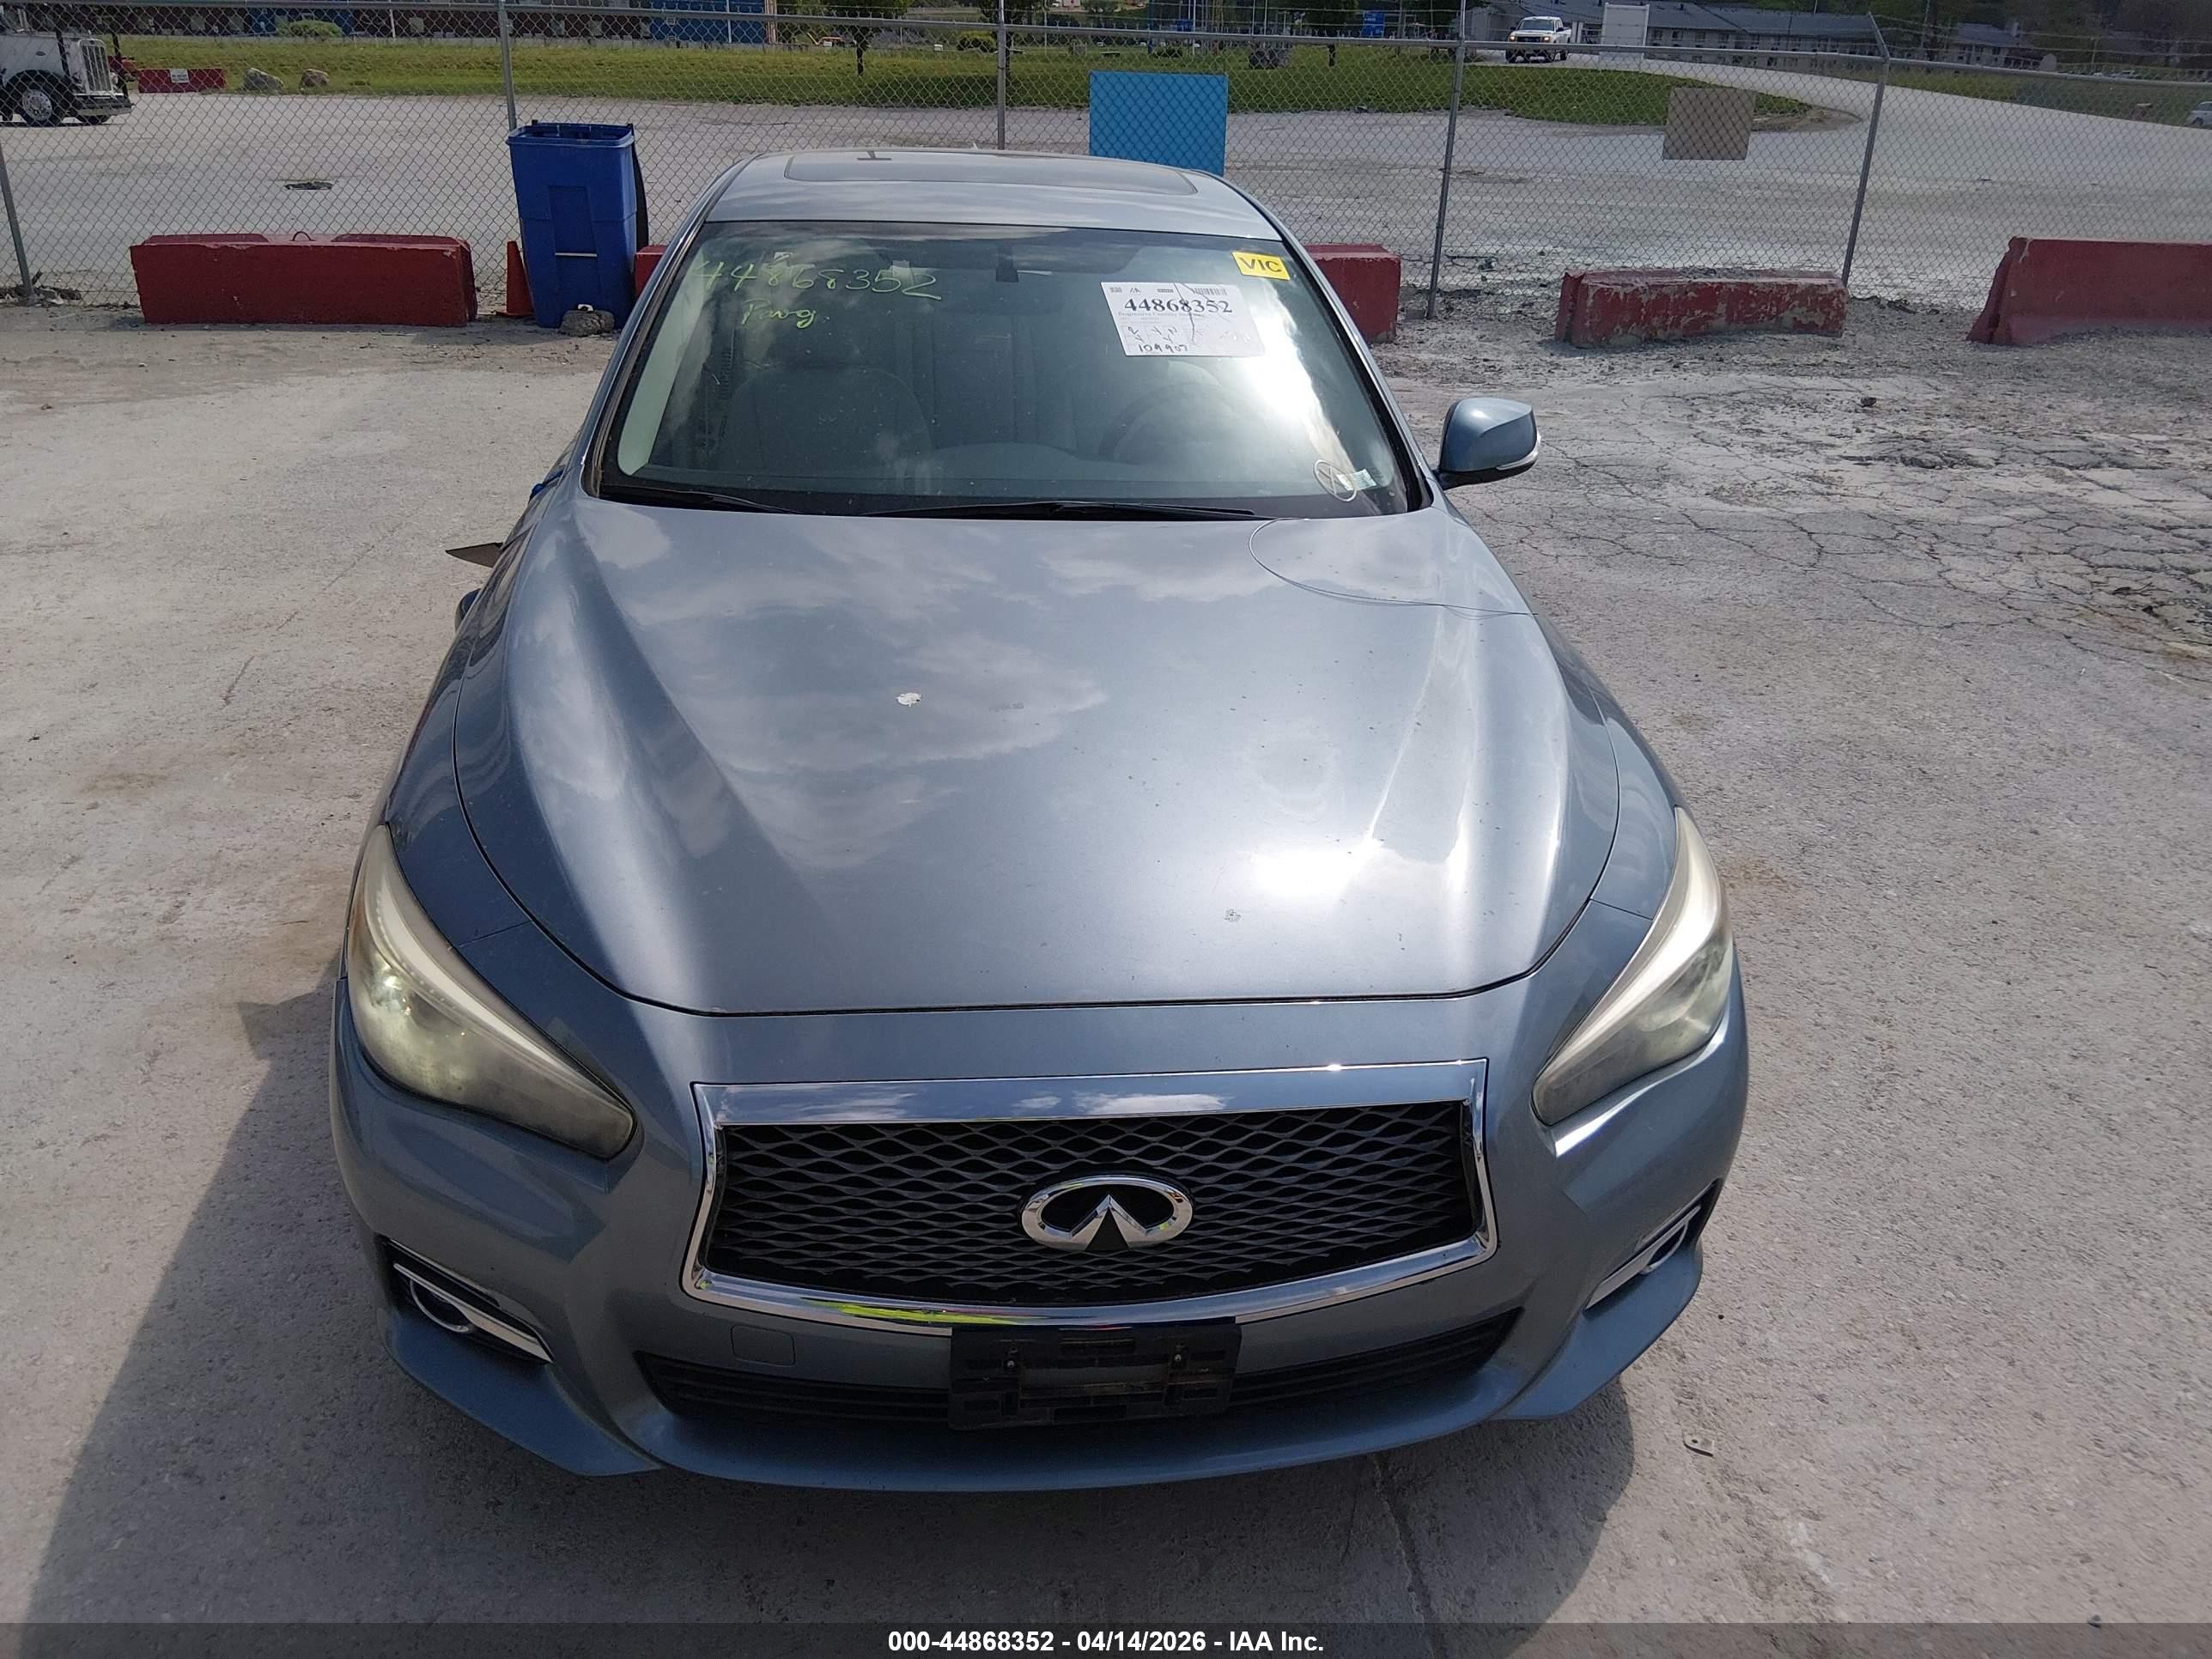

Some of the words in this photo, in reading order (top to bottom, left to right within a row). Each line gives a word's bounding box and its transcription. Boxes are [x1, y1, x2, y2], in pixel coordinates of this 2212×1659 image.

[1239, 257, 1282, 273] VIC
[692, 260, 942, 301] 44868352
[1124, 298, 1233, 313] 44868352
